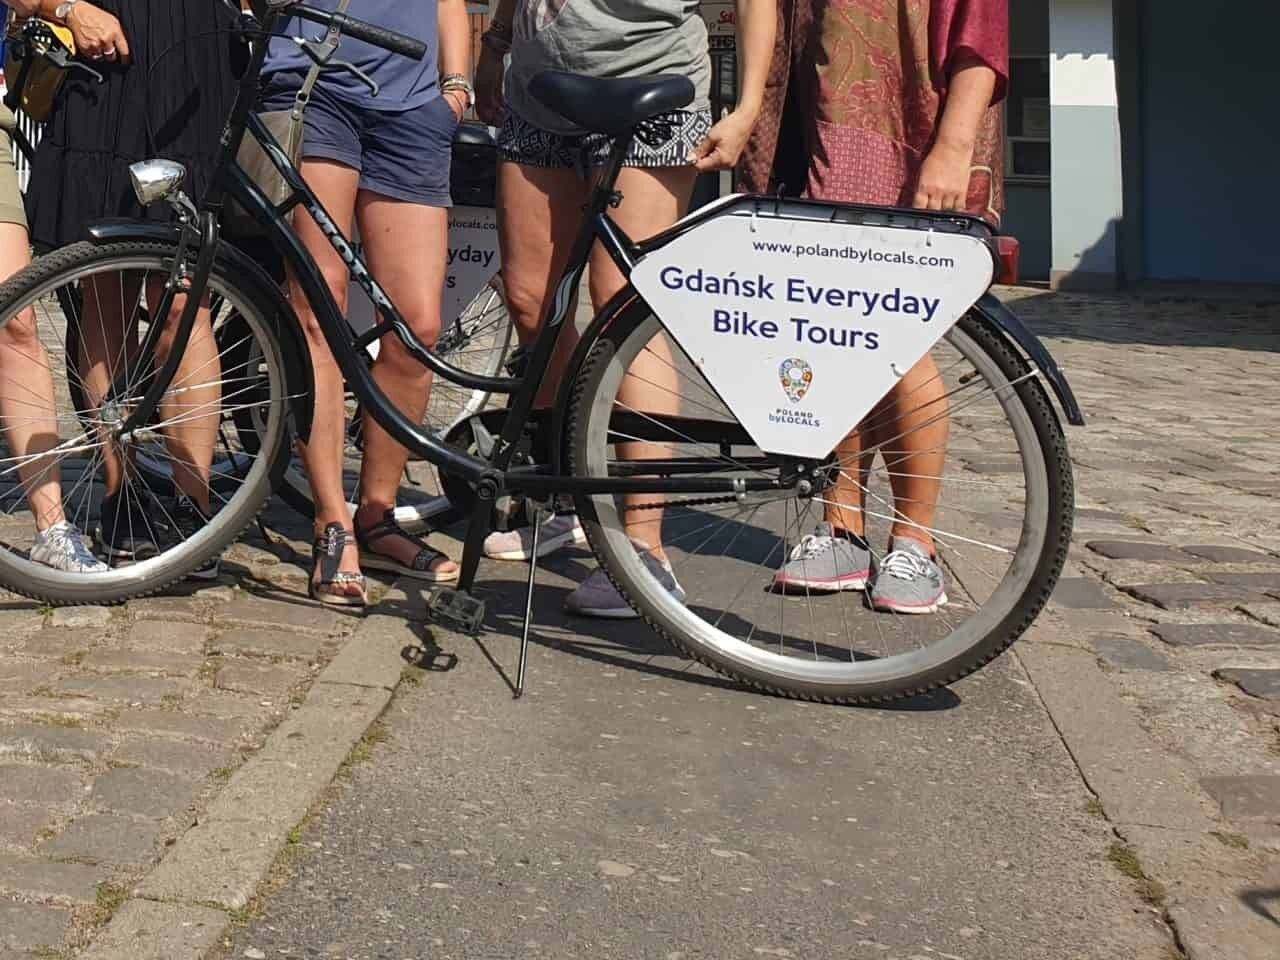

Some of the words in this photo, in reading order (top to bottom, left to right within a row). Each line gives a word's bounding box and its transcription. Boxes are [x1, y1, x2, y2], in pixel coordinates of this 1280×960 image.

[752, 239, 954, 268] www.polandbylocals.com
[660, 266, 774, 300] Gdańsk
[786, 277, 940, 322] Everyday
[713, 309, 779, 339] Bike
[790, 318, 880, 350] Tours
[768, 413, 821, 428] byLOCALS
[776, 408, 813, 419] POLAND
